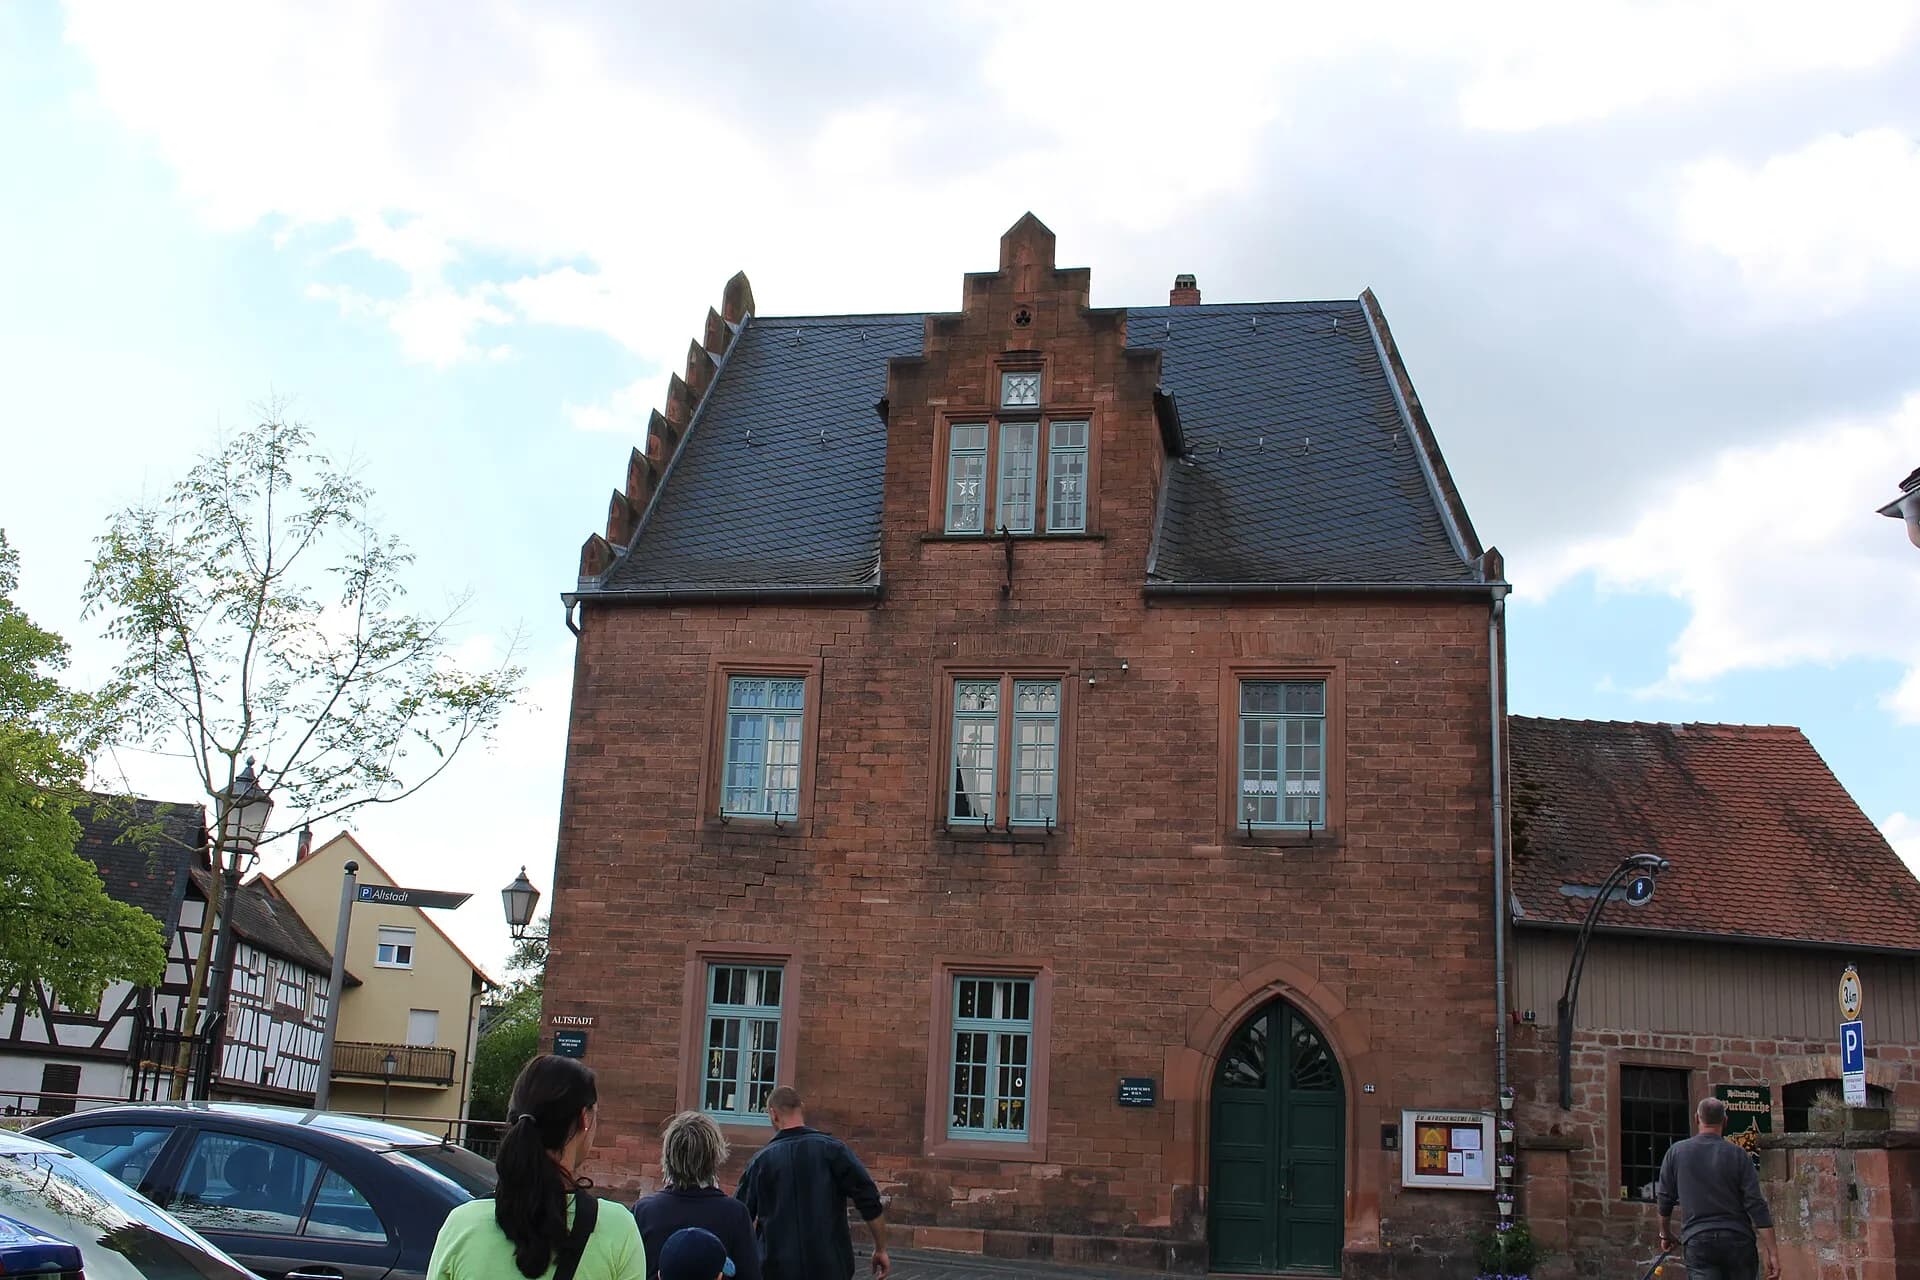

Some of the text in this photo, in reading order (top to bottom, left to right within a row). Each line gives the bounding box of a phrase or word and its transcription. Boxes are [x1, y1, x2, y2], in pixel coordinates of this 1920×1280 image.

[1637, 882, 1643, 894] P
[372, 889, 409, 902] Altstadt
[552, 1016, 594, 1025] ALTSTADT
[1846, 1030, 1857, 1065] P
